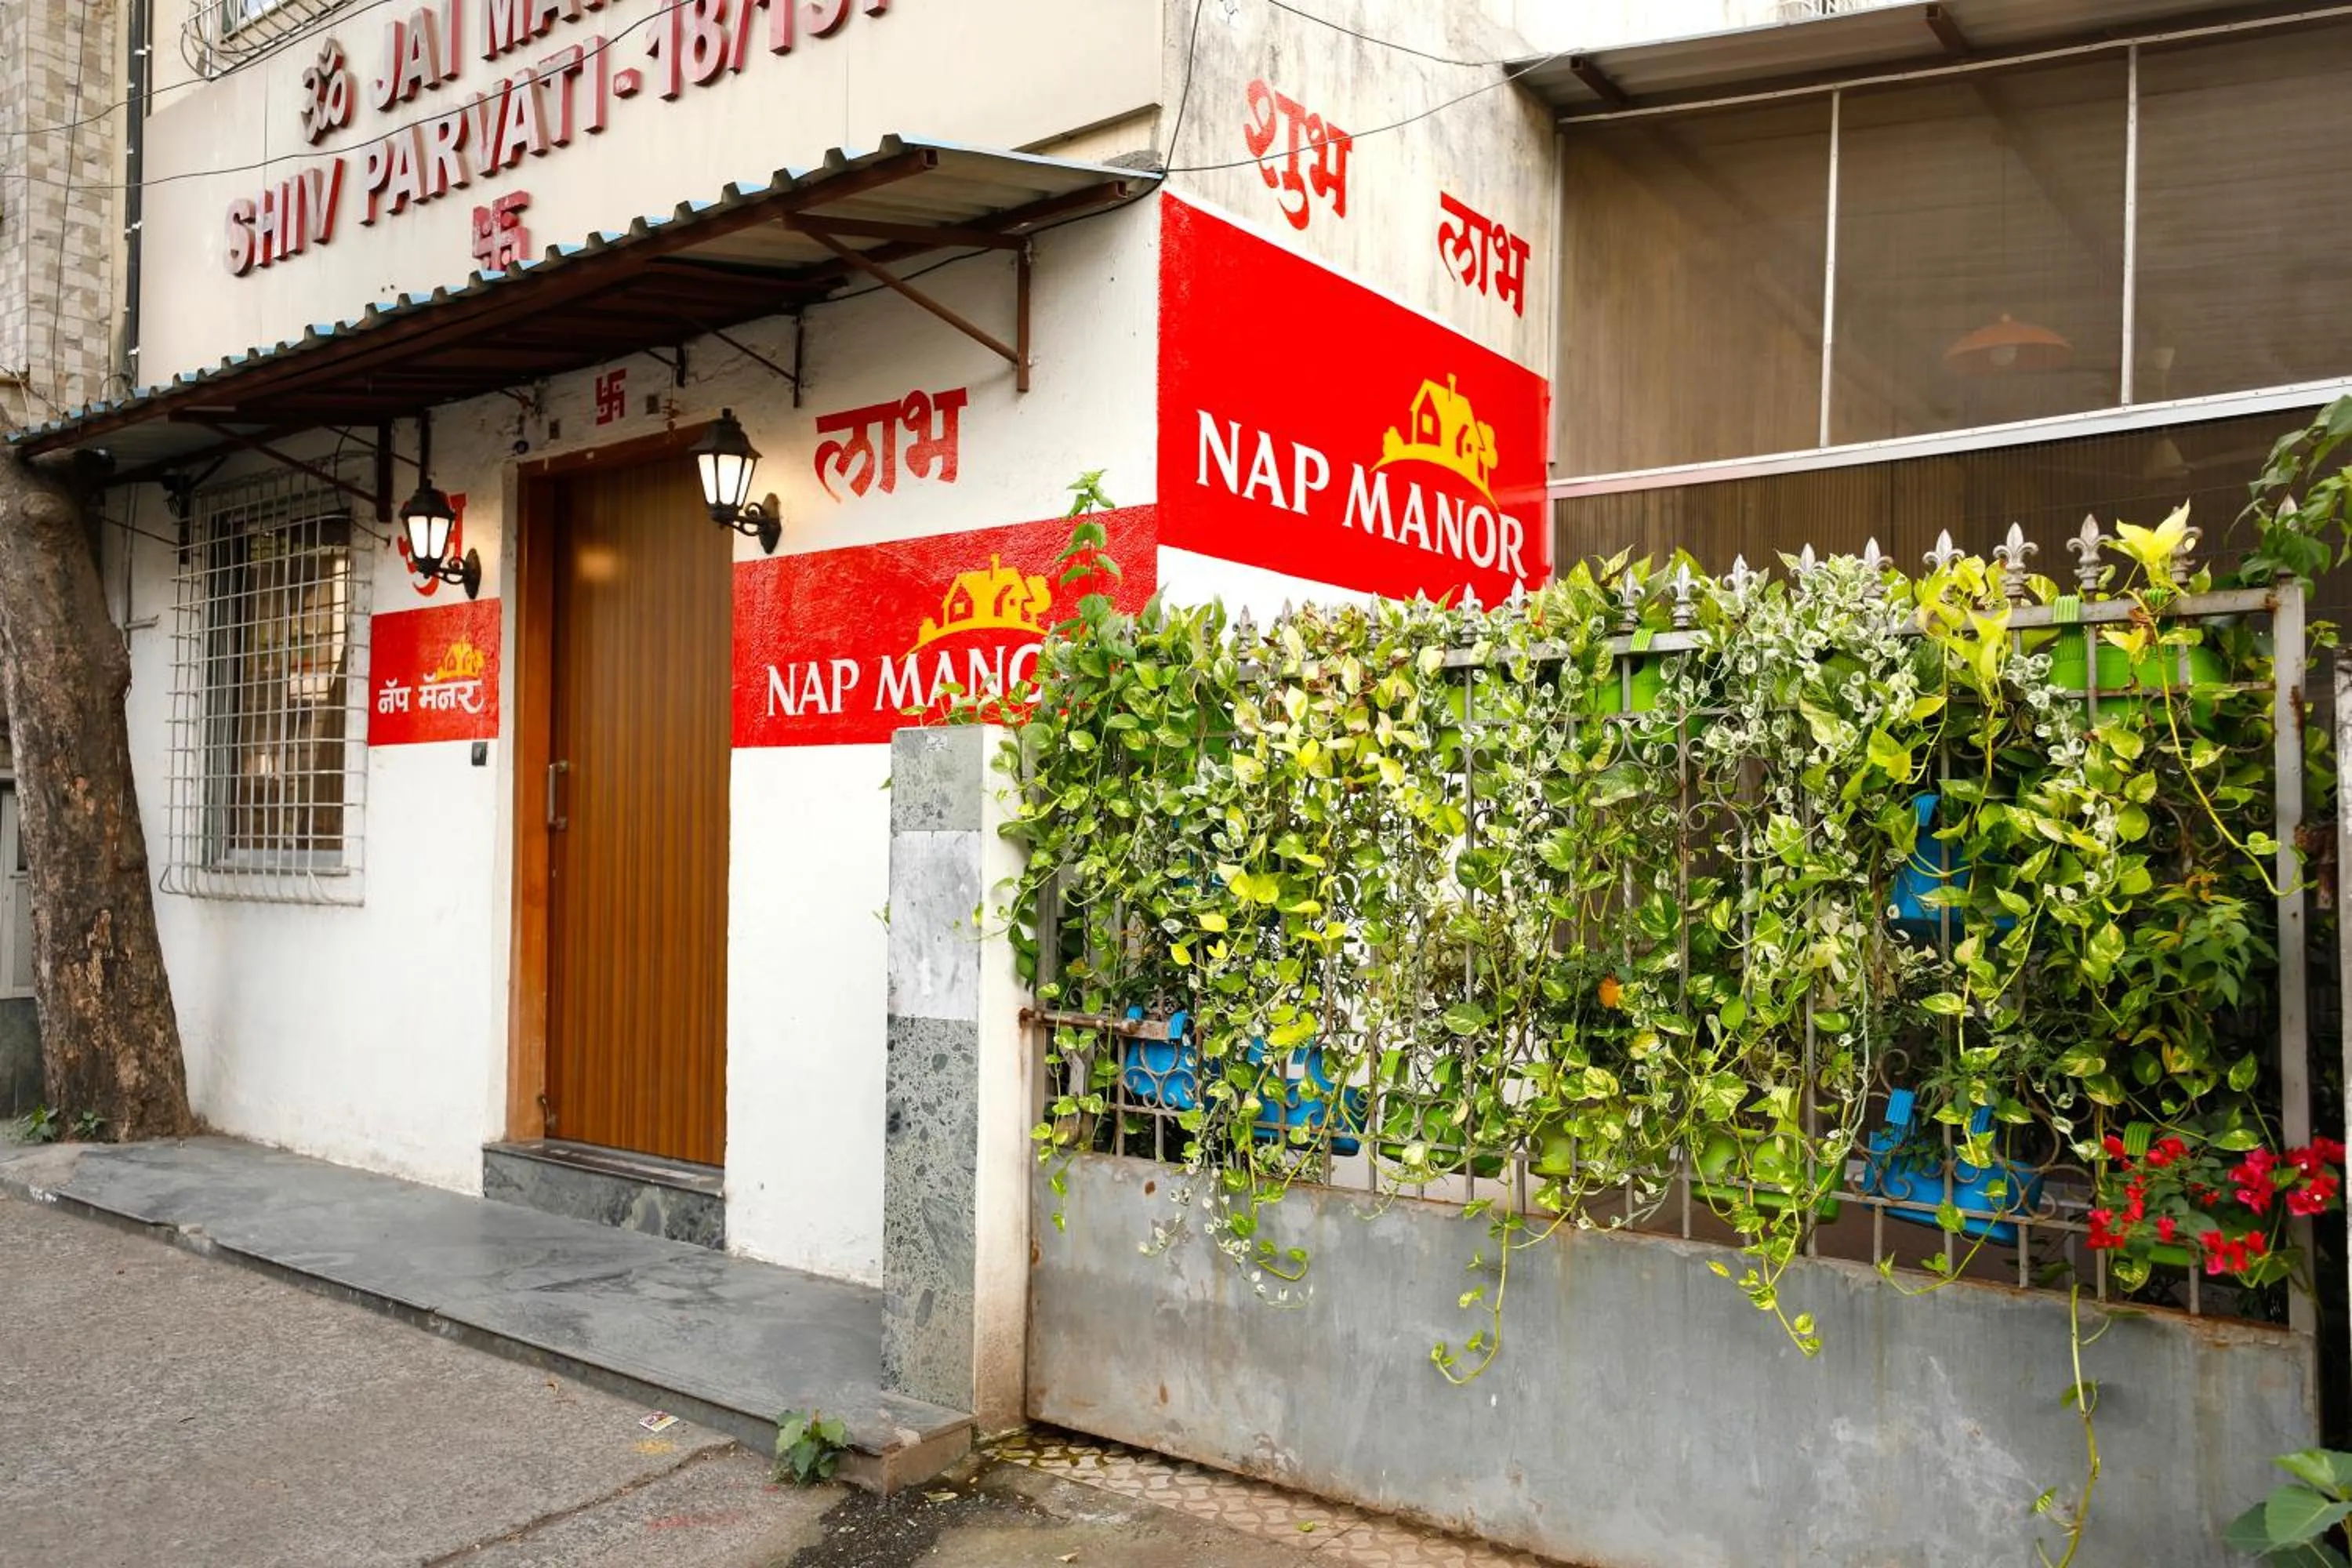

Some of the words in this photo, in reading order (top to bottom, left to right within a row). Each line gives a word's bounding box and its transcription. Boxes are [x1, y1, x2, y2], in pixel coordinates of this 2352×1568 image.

[368, 0, 463, 111] JAI
[223, 157, 344, 277] SHIV
[1243, 77, 1354, 231] शुभ
[1437, 190, 1531, 319] लाभ
[814, 387, 968, 503] लाभ
[1196, 408, 1330, 515] NAP
[1341, 463, 1529, 579] MANOR
[378, 677, 412, 714] नॅप
[418, 673, 485, 714] मॅनर
[766, 659, 859, 716] NAP
[875, 643, 1047, 711] MANO
